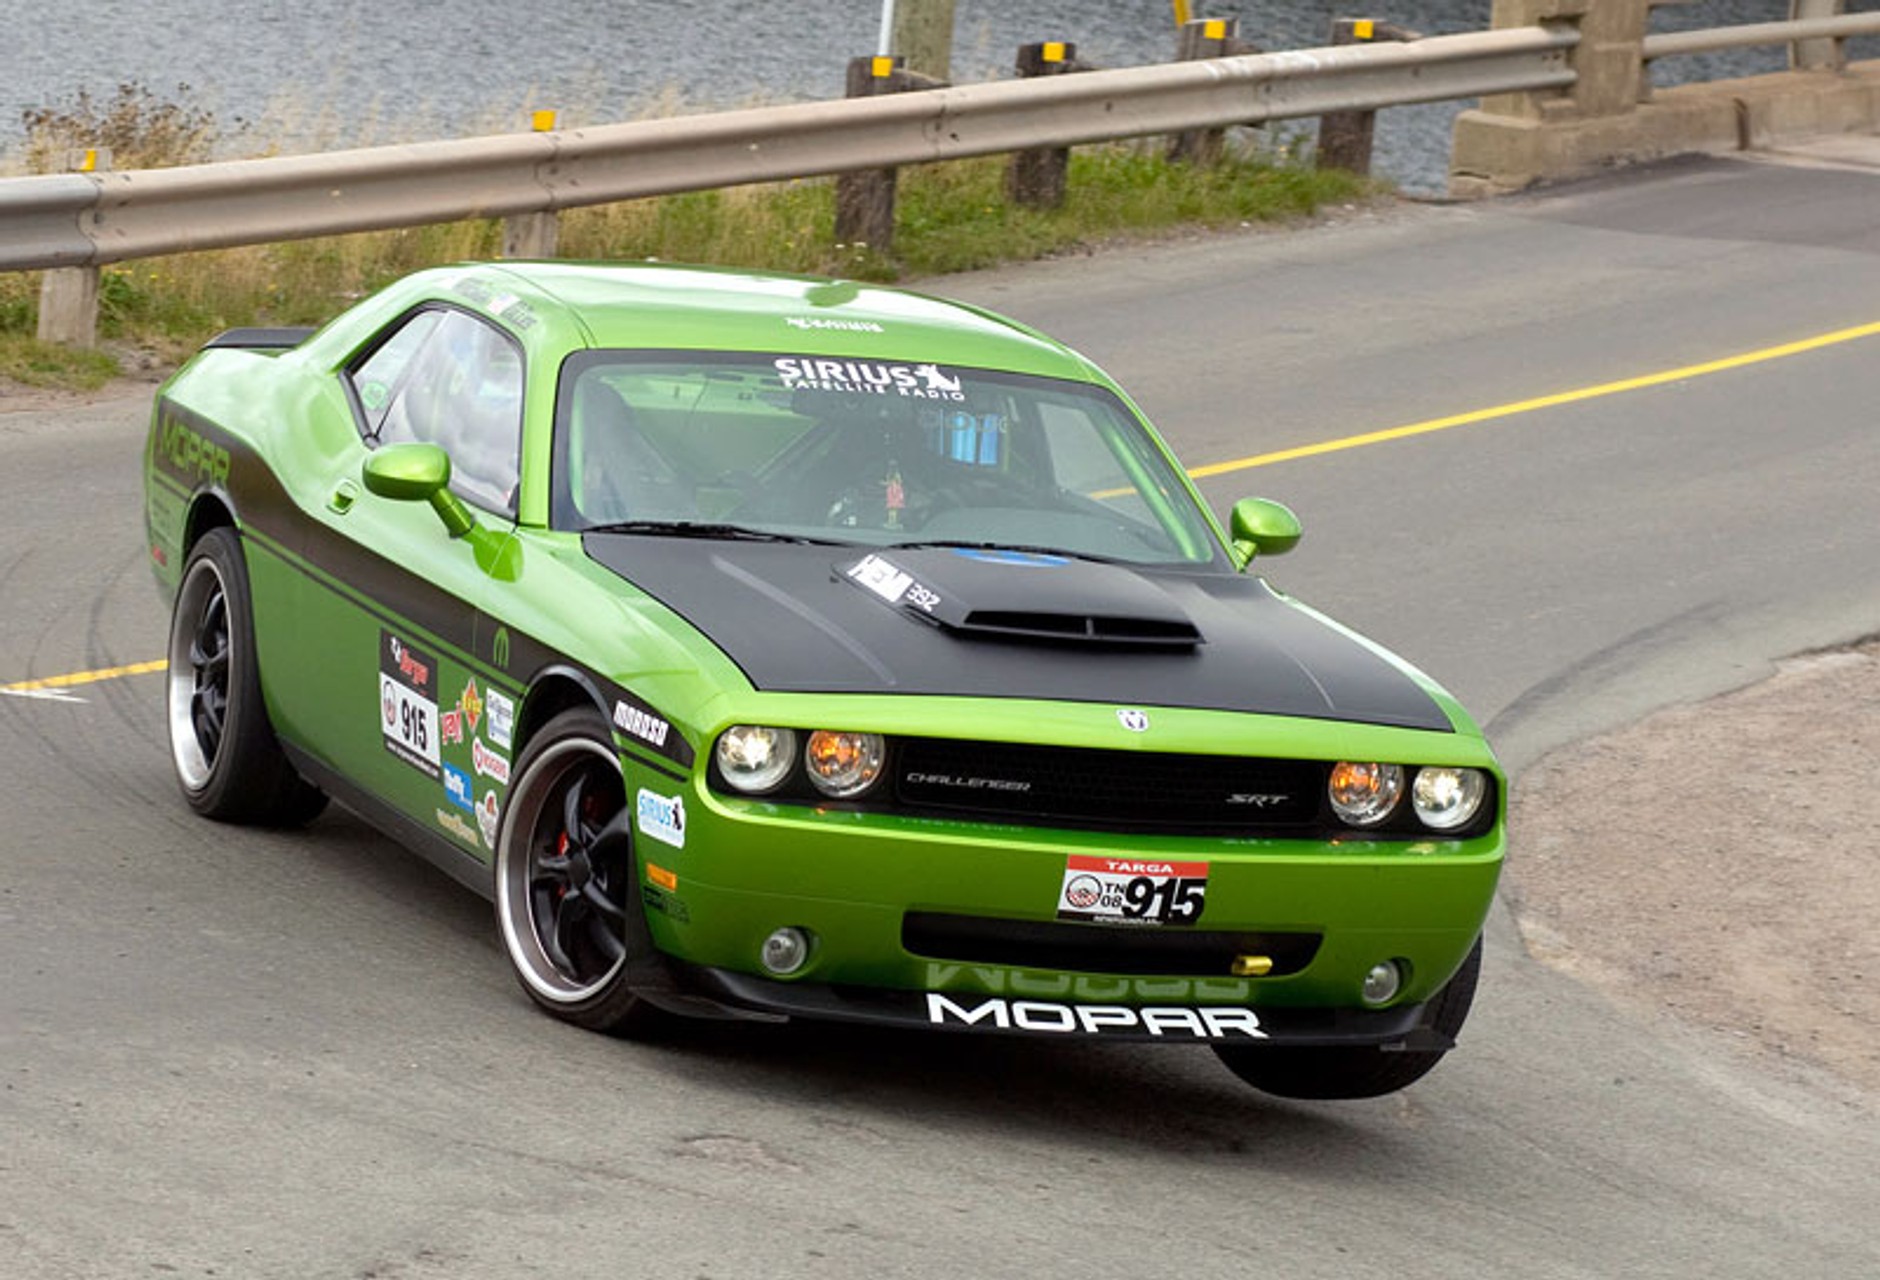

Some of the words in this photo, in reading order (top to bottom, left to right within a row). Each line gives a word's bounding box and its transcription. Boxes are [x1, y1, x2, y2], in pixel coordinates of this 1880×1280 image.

[774, 359, 919, 388] SIRIUS
[896, 387, 965, 401] RADIO
[906, 583, 941, 613] 392
[402, 698, 426, 750] 915
[613, 700, 669, 746] MOROSO
[907, 772, 1031, 792] CHALLENGER
[638, 796, 672, 827] SIRIUS
[1226, 793, 1288, 807] SRT
[1106, 861, 1173, 873] TARGA
[1100, 894, 1122, 908] 08
[1105, 882, 1126, 894] TN
[1122, 876, 1207, 925] 915
[926, 993, 1270, 1039] MOPAR
